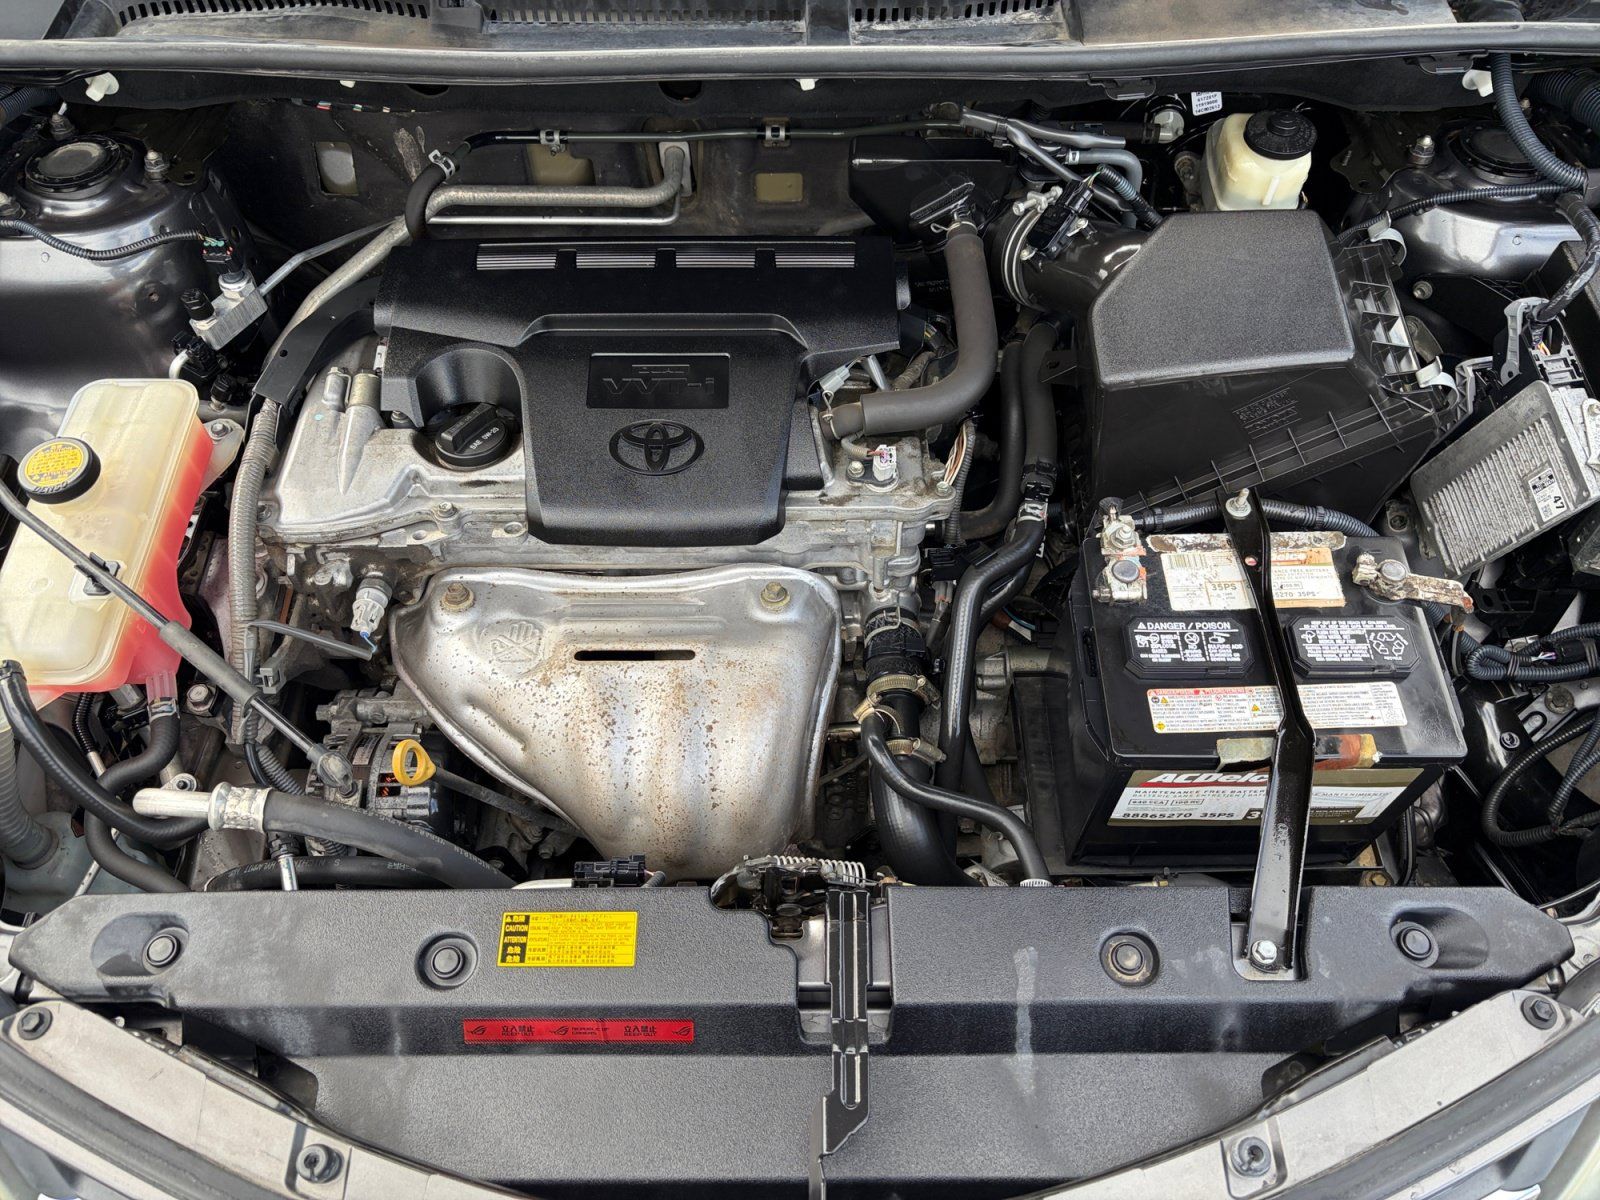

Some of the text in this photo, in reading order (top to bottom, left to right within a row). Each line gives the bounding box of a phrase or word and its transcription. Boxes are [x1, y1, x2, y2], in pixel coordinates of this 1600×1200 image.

[469, 439, 483, 450] SAE
[32, 480, 69, 494] DENSO
[1553, 495, 1565, 509] 47
[1211, 583, 1237, 592] 35PS
[1147, 622, 1186, 630] DANGER
[1195, 622, 1231, 630] POISON
[1147, 772, 1269, 783] ACDelc
[505, 924, 528, 932] CAUTION
[504, 936, 527, 944] ATTENTION
